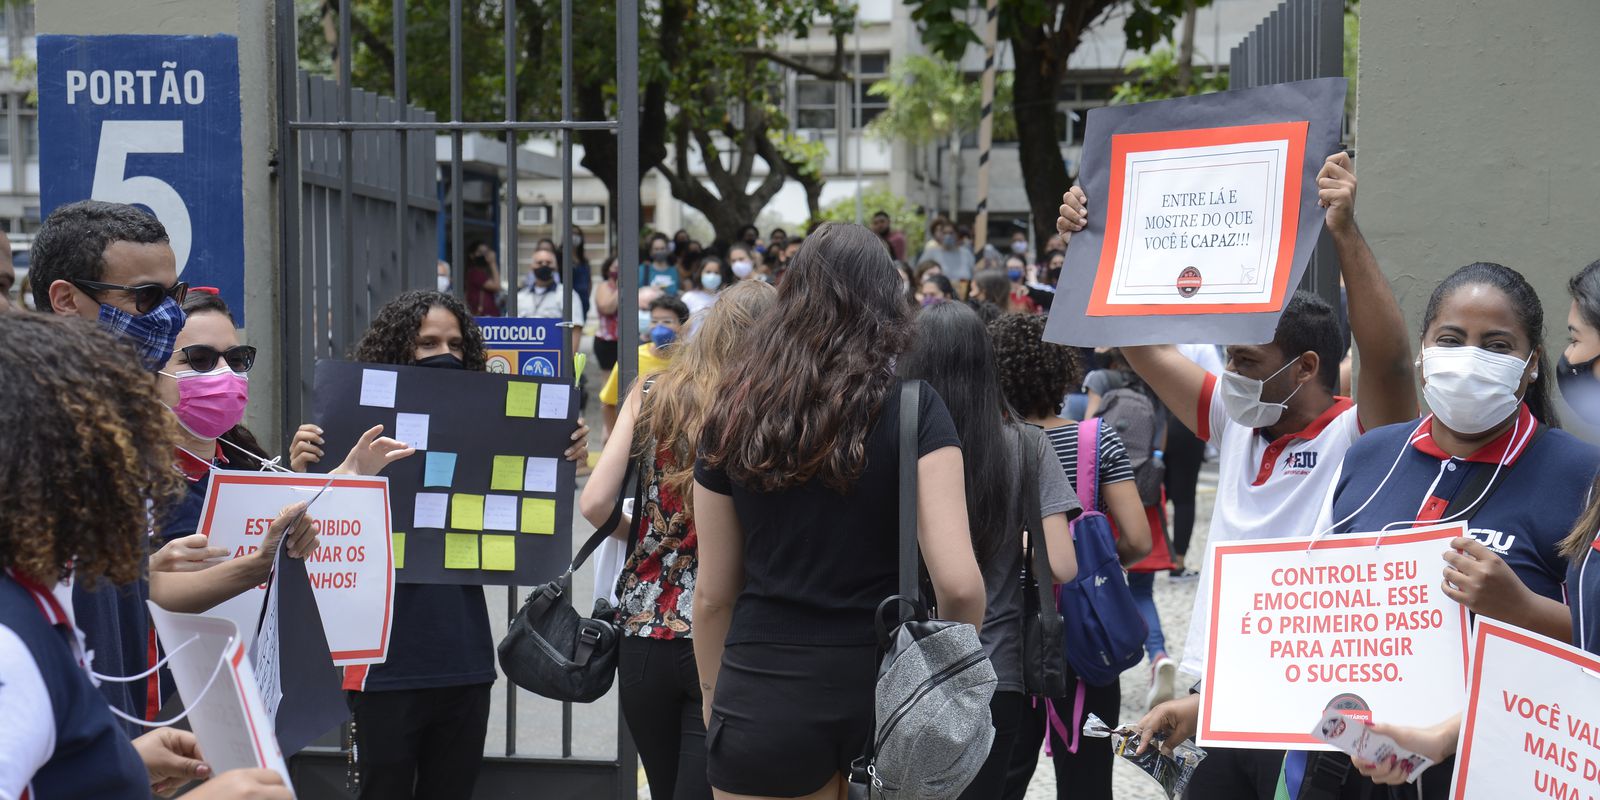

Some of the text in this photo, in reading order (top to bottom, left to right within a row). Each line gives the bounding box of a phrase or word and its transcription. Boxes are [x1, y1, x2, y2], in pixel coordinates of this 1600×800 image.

[66, 61, 206, 105] PORTÃO
[90, 120, 193, 278] 5
[1161, 186, 1238, 208] ENTRE LÁ E
[1144, 210, 1254, 230] MOSTRE DO QUE
[1144, 231, 1250, 250] VOCÊ É CAPAZ!!!
[479, 325, 546, 341] OTOCOLO
[315, 519, 362, 537] OIBIDO
[346, 545, 366, 562] OS
[308, 572, 357, 590] NHOS!
[1271, 559, 1418, 587] CONTROLE SEU
[1253, 584, 1429, 611] EMOCIONAL. ESSE
[1241, 608, 1443, 635] É O PRIMEIRO PASSO
[1270, 636, 1414, 659] PARA ATINGIR
[1284, 662, 1403, 683] O SUCESSO.
[1503, 690, 1600, 750] VOCÊ VAL
[1524, 732, 1600, 784] MAIS D
